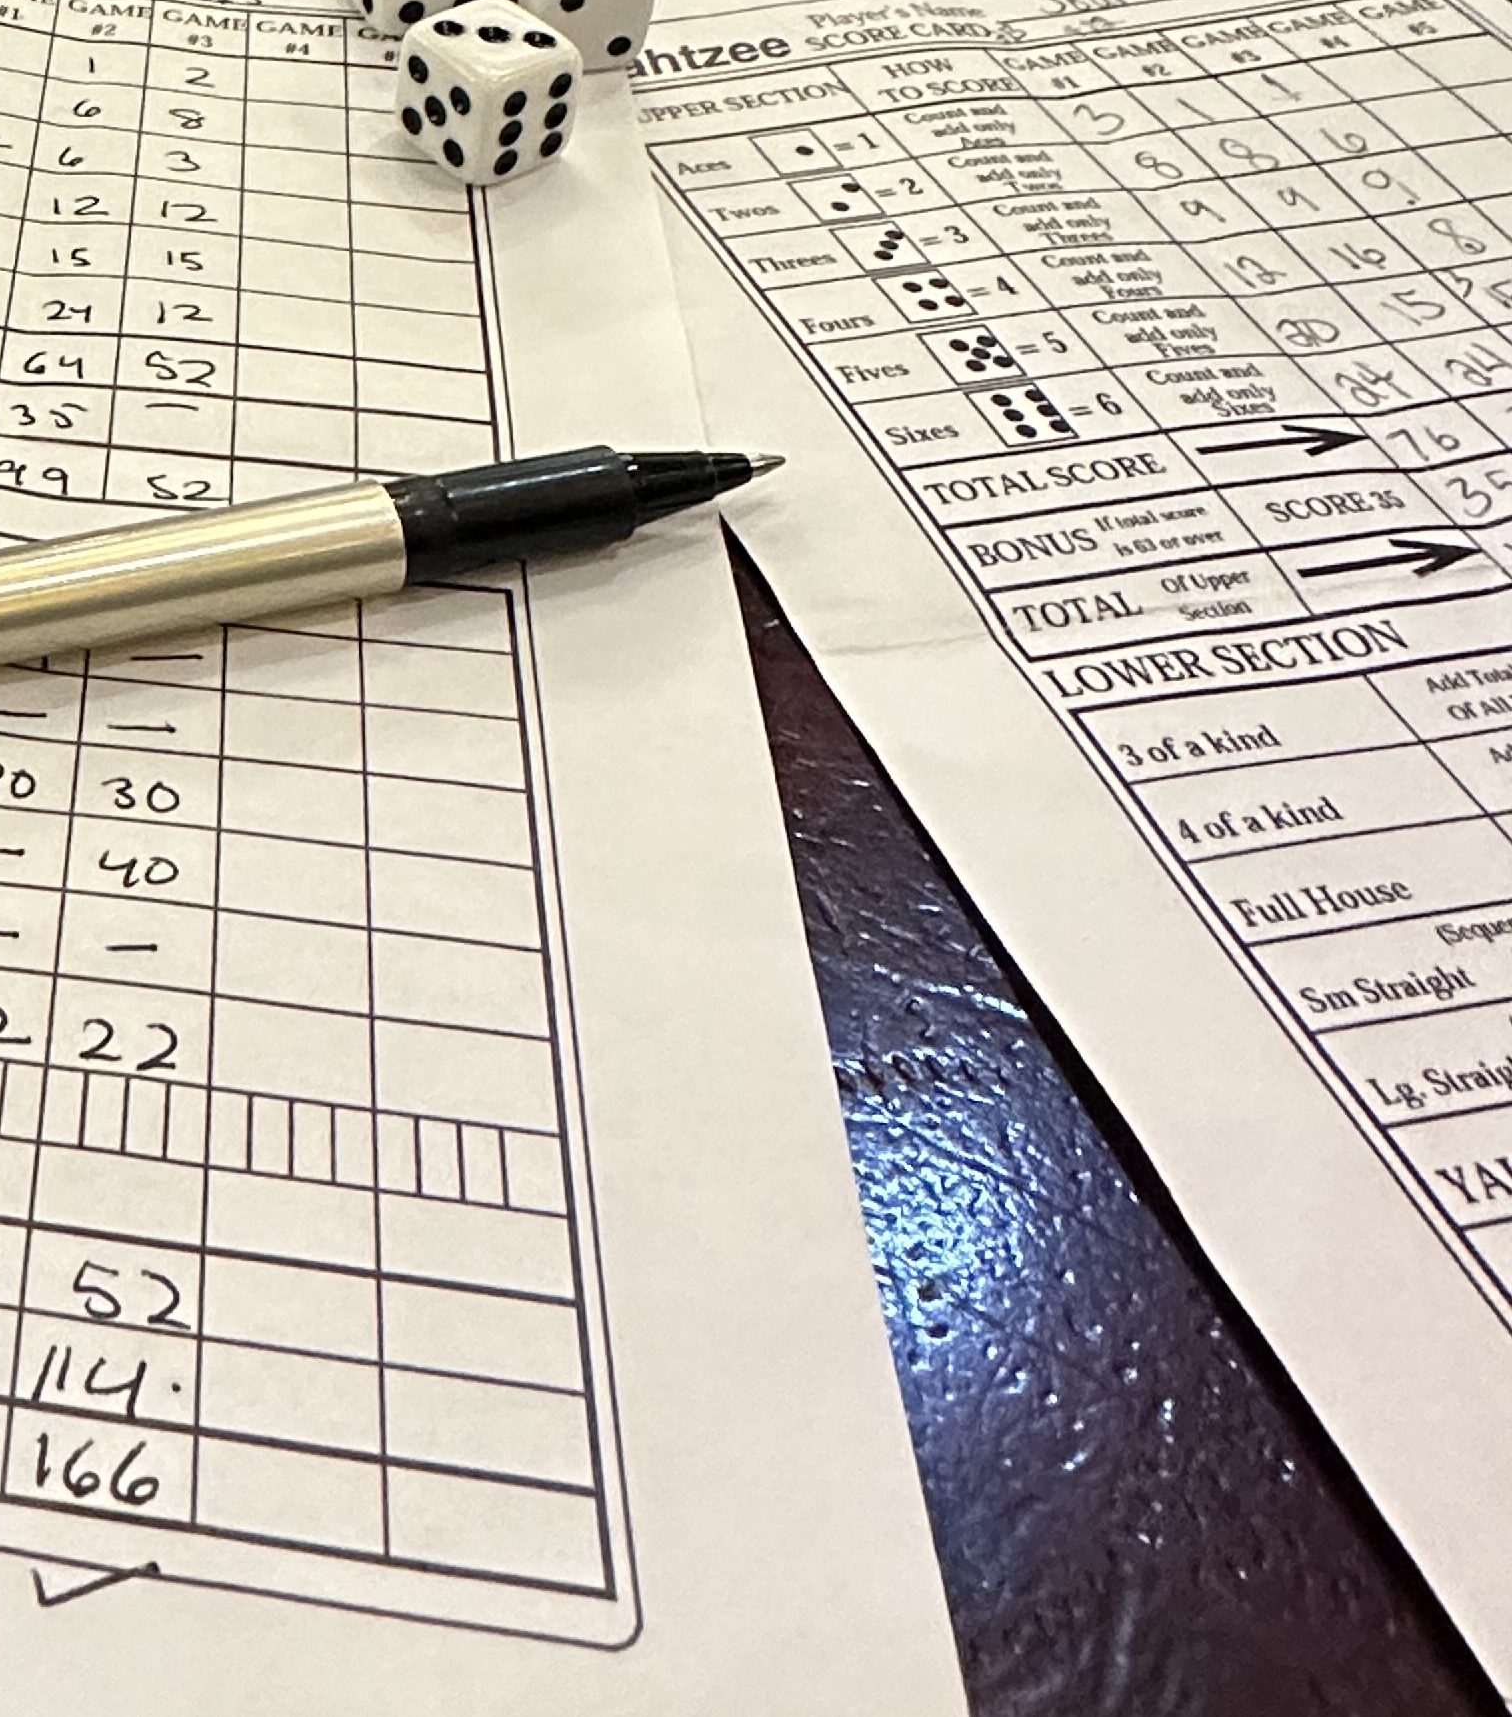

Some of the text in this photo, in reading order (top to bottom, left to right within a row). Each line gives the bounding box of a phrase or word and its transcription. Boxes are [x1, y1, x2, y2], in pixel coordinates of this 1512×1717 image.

[162, 8, 249, 34] GAME
[920, 0, 986, 20] Name
[256, 19, 344, 40] GAME
[805, 26, 906, 52] SCORE
[909, 21, 991, 44] CARD
[627, 36, 792, 80] ahtzee
[727, 81, 849, 112] SECTION
[677, 158, 733, 178] Aces
[52, 195, 109, 219] 12
[160, 199, 218, 224] 12
[708, 202, 781, 223] Twos
[51, 246, 92, 267] 15
[165, 249, 203, 271] 15
[748, 250, 838, 275] Threes
[42, 299, 92, 323] 24
[156, 299, 214, 323] 12
[799, 312, 876, 335] Fours
[23, 349, 85, 379] 64
[145, 350, 216, 387] 52
[835, 360, 912, 385] Fives
[10, 401, 88, 429] 35
[884, 421, 960, 447] Sixes
[1386, 425, 1461, 462] 76
[146, 474, 214, 502] 52
[923, 450, 1168, 507] TOTAL SCORE
[966, 525, 1099, 569] BONUS
[1011, 590, 1145, 634] TOTAL
[1040, 619, 1411, 701] LOWER SECTION
[1118, 722, 1283, 769] 3 of a kind
[100, 779, 181, 814] 30
[98, 848, 181, 888] 40
[1229, 880, 1415, 928] Full House
[1298, 964, 1477, 1015] Sm Straight
[77, 1017, 180, 1073] 22
[1367, 1055, 1512, 1111] Lg. Straig
[71, 1260, 192, 1331] 52
[35, 1431, 161, 1506] 166
